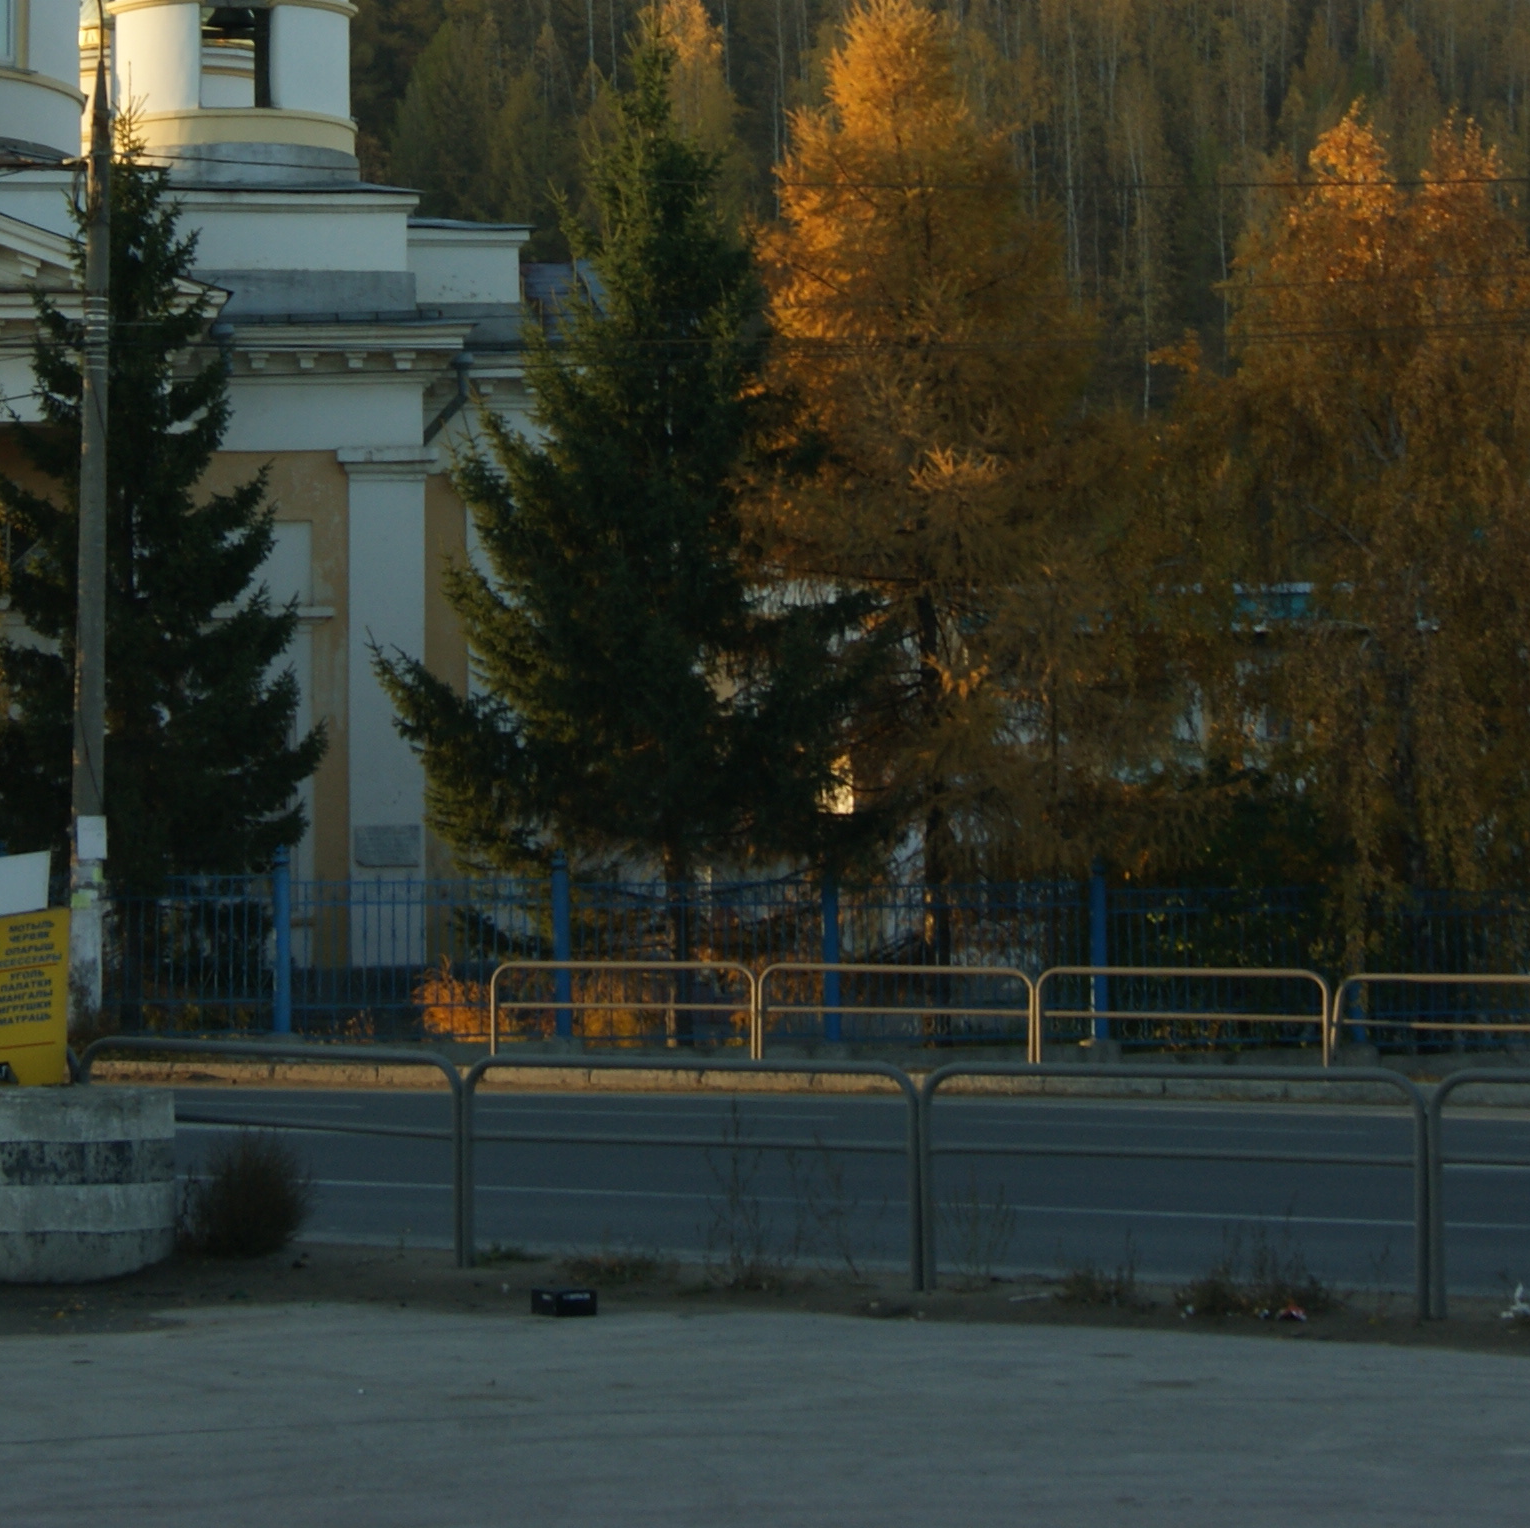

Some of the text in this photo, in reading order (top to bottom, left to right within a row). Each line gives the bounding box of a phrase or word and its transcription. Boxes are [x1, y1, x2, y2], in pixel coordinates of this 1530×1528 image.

[8, 920, 55, 932] МОТЫЛЬ
[5, 943, 54, 956] ОПАРЫШ
[10, 970, 45, 981] УГОЛЬ
[0, 979, 52, 992] ПАЛАТКИ
